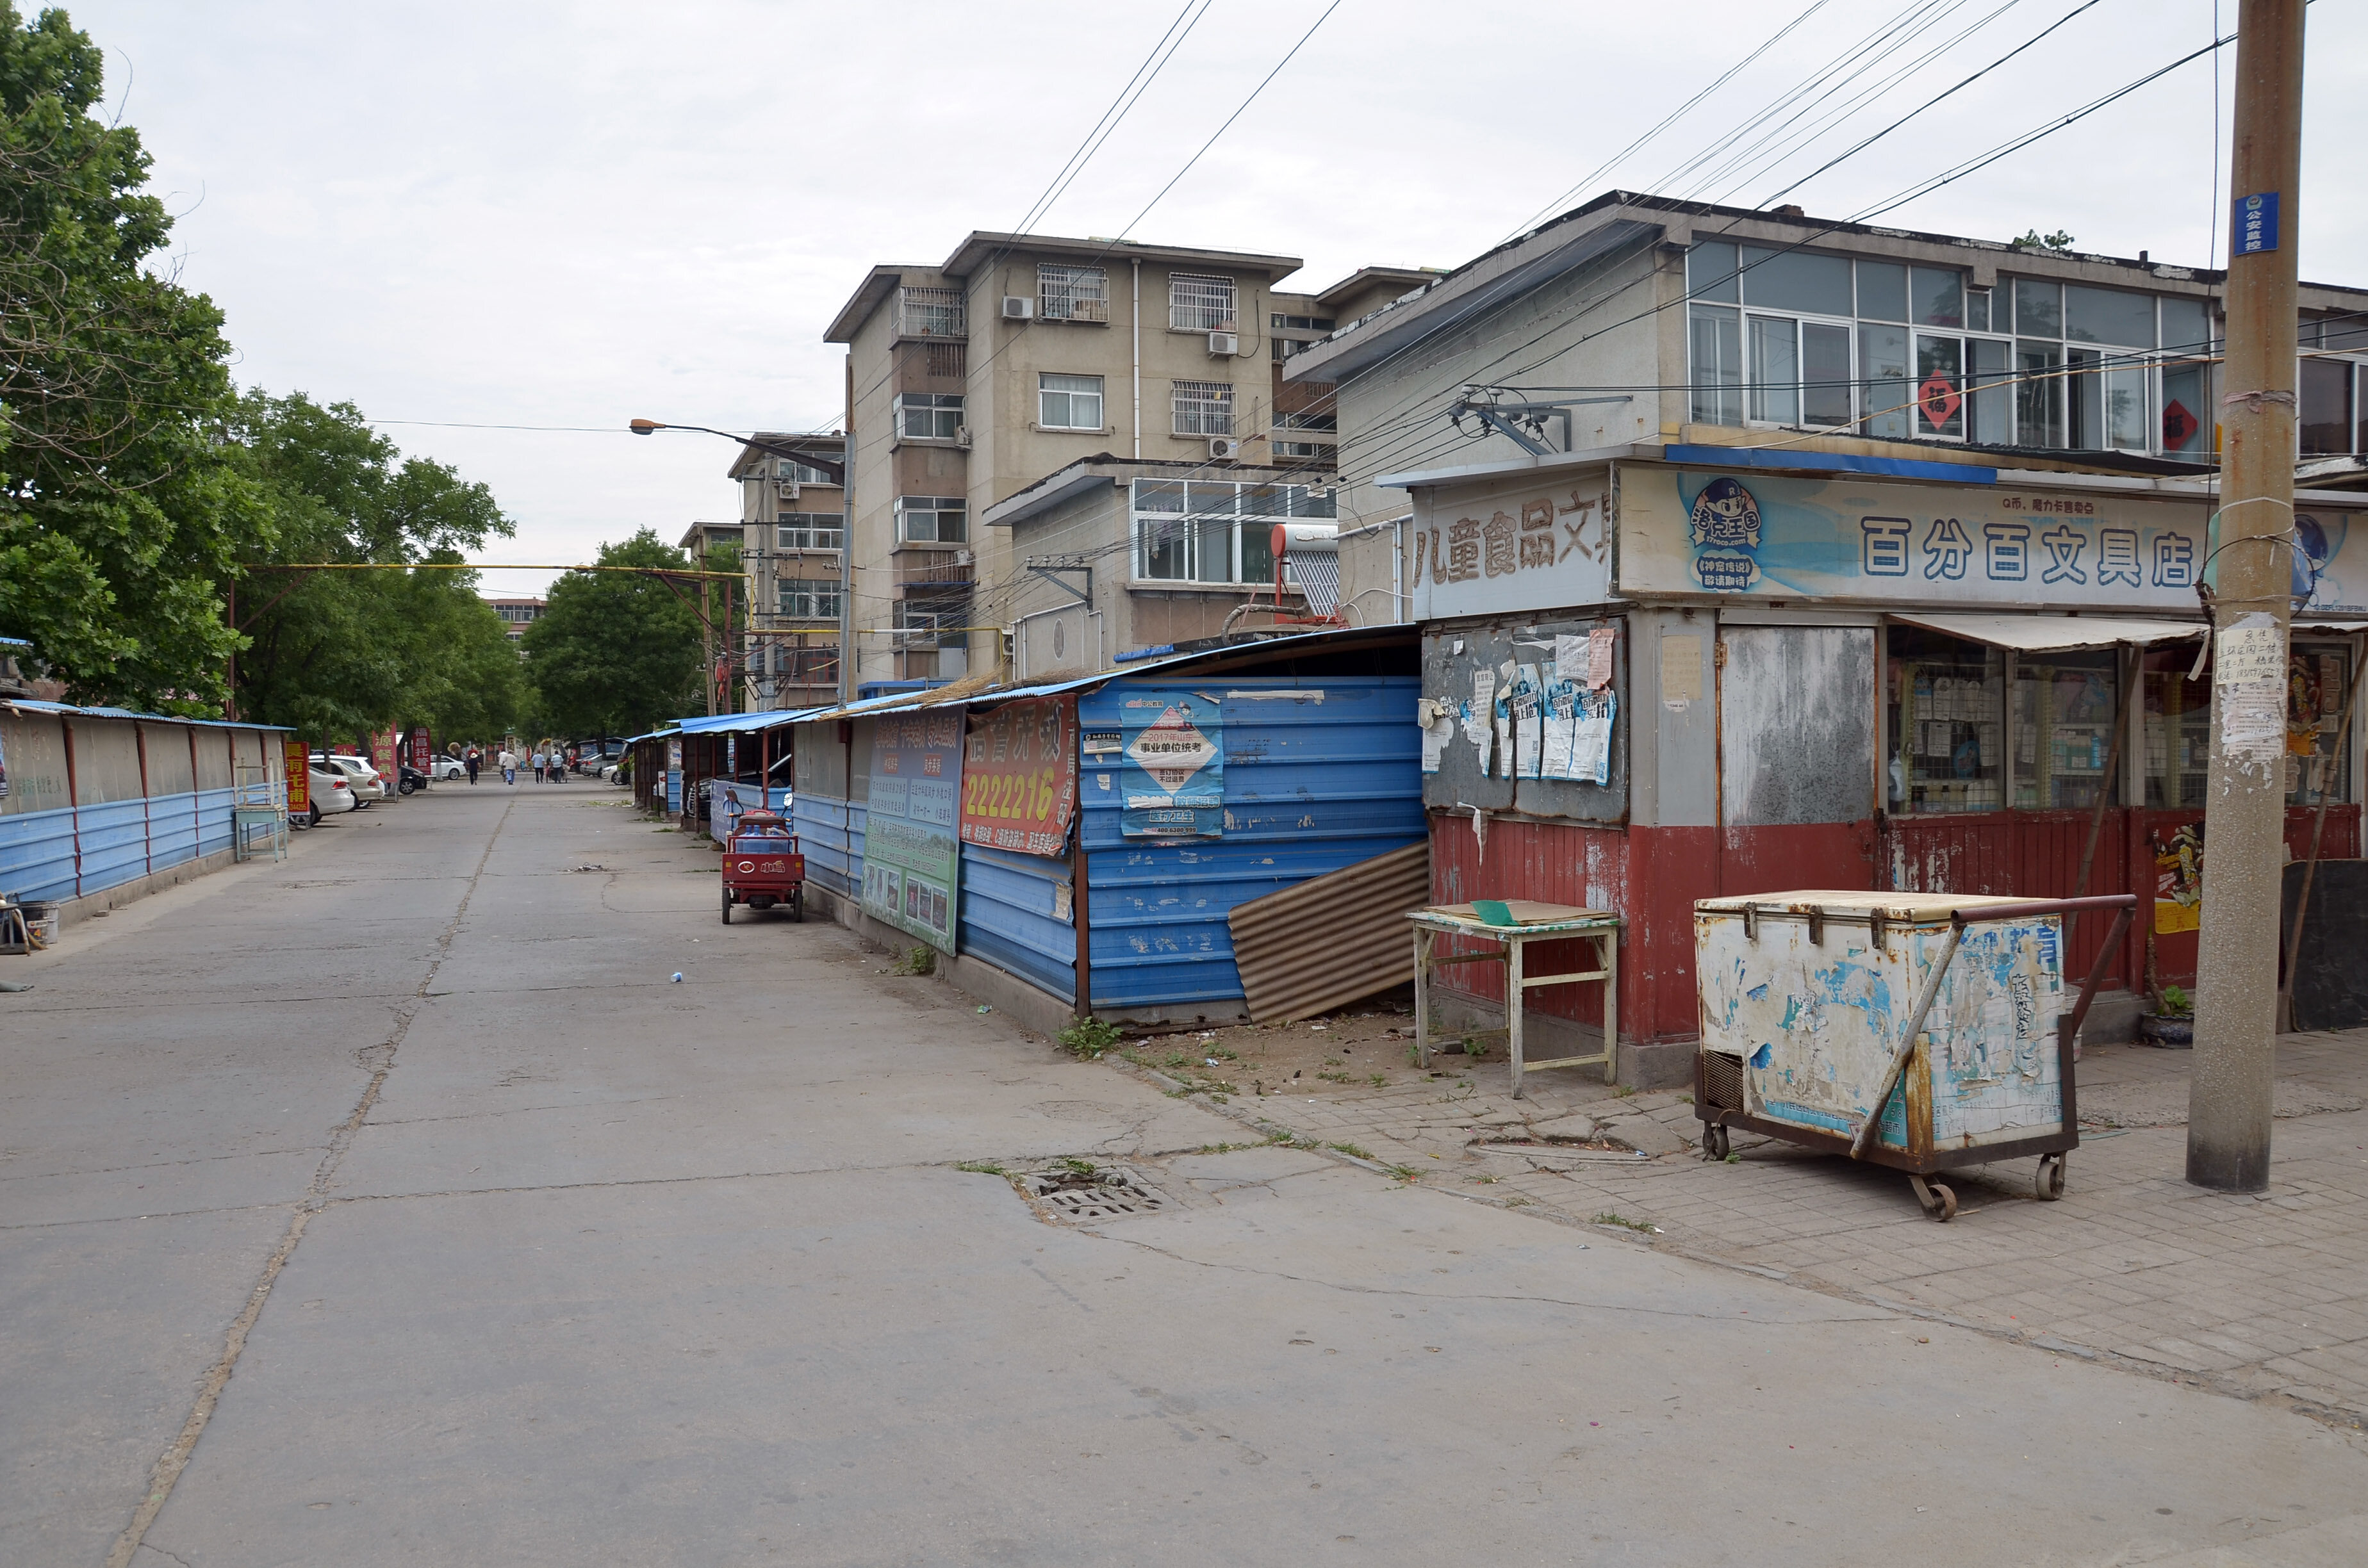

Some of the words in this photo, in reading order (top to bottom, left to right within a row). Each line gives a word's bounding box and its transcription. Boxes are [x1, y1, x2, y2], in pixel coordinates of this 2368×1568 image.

[2245, 210, 2262, 251] 公安监控
[1927, 386, 1947, 413] 福
[1690, 506, 1761, 538] 洛克王国
[1706, 535, 1747, 546] 17roco.com
[1861, 514, 2194, 589] 百分百文具店
[1704, 574, 1746, 587] 敬请期待
[927, 715, 958, 748] 专业品质
[1148, 733, 1194, 742] 2017年山东
[375, 724, 393, 775] 源餐桌
[1140, 742, 1202, 753] 事业单位统考
[924, 758, 942, 773] 同步英语
[966, 765, 1055, 822] 2222216
[1176, 796, 1219, 808] 教师招聘
[1149, 810, 1194, 822] 医疗卫生
[761, 860, 785, 873] 小鸟
